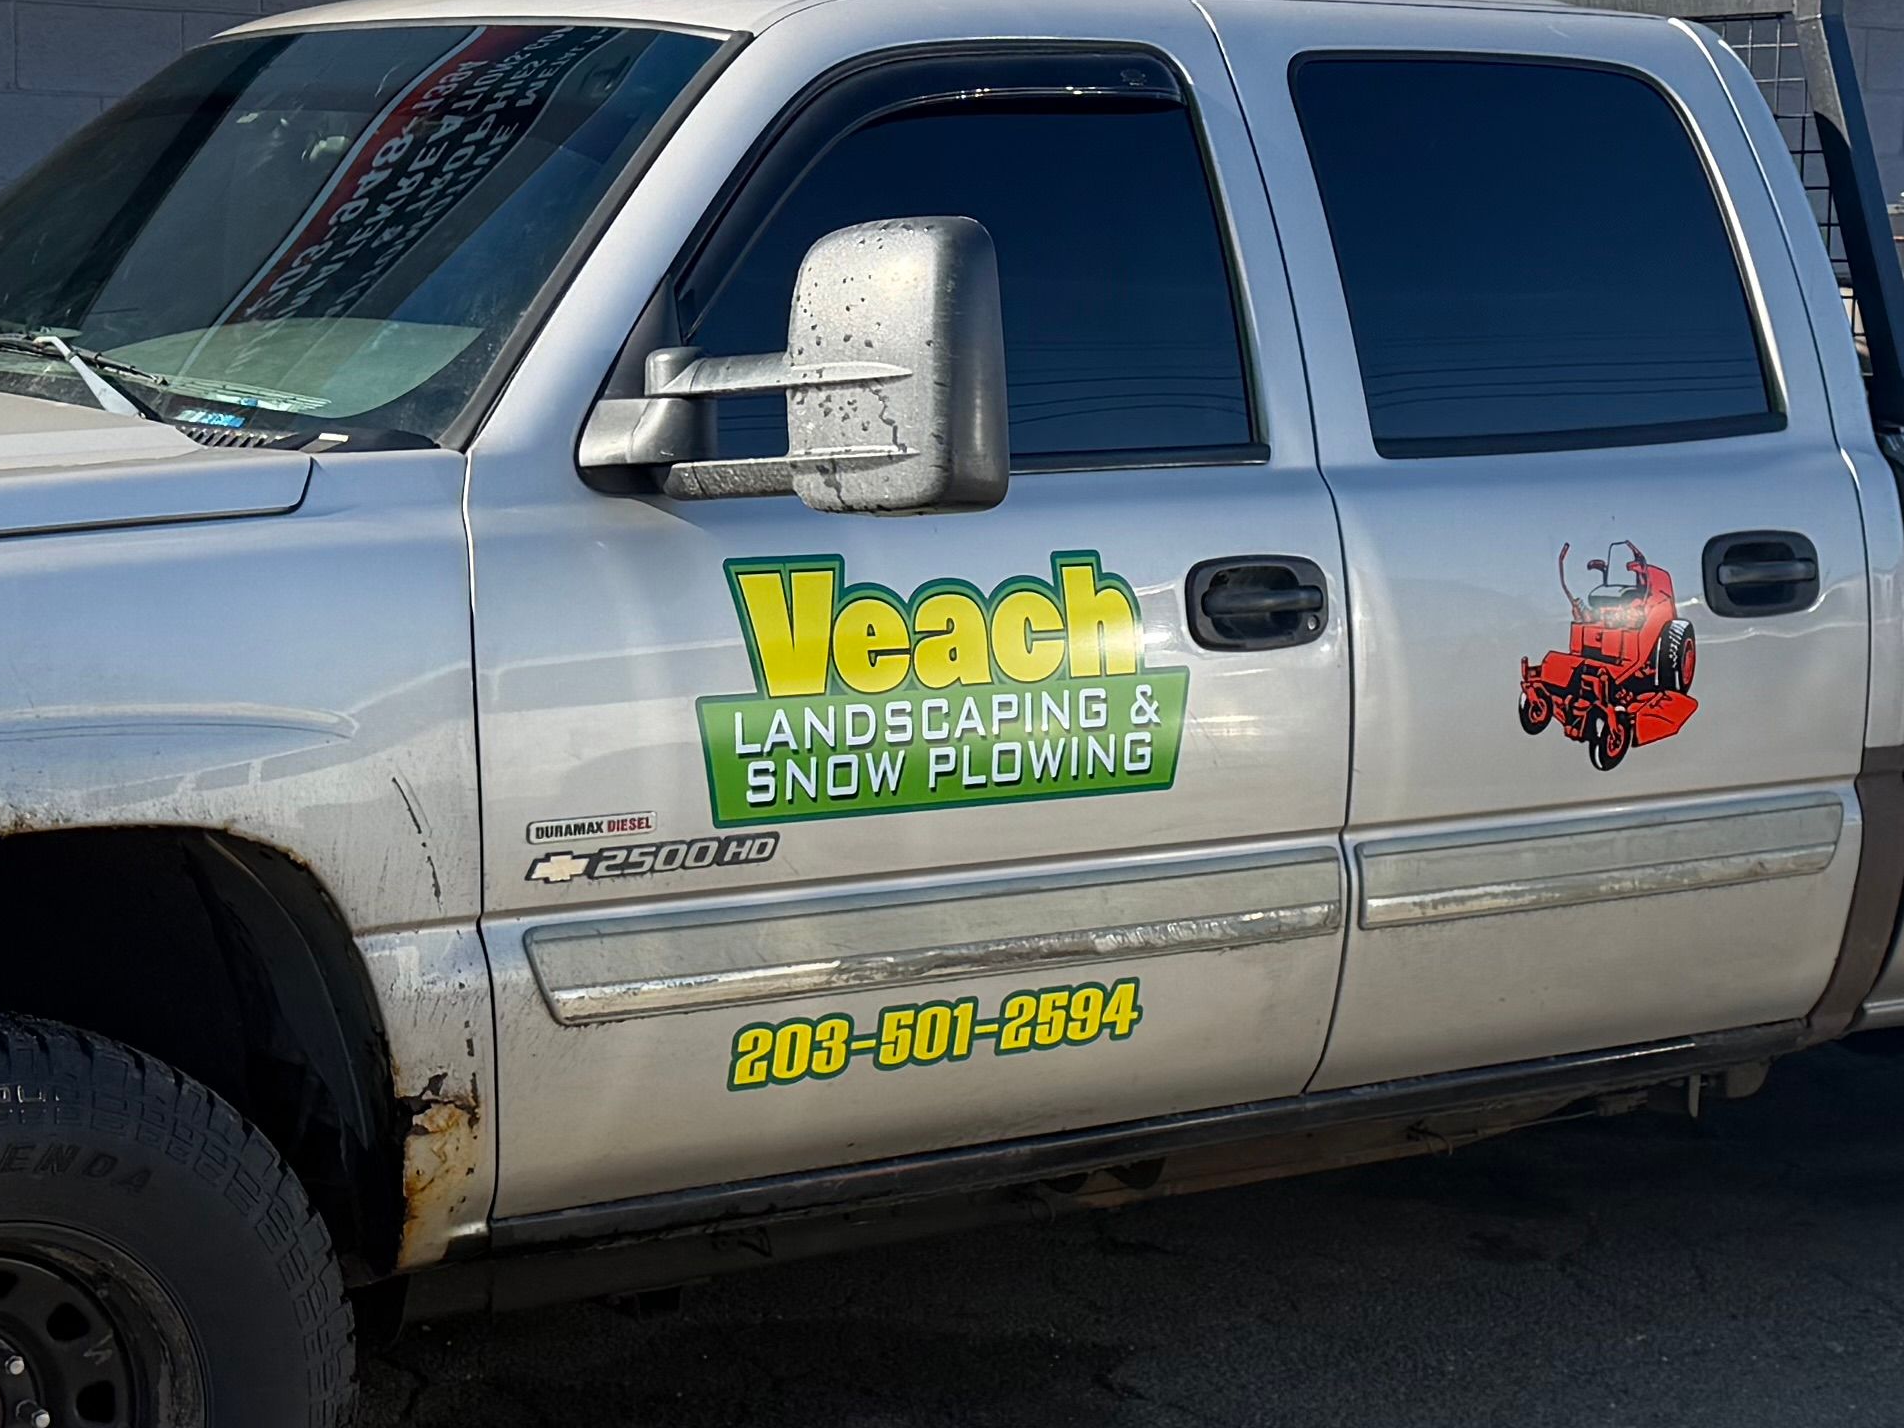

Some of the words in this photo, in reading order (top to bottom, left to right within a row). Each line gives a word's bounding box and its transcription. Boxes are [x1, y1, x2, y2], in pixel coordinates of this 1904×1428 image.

[734, 565, 1139, 699] Veach
[733, 686, 1108, 757] LANDSCAPING
[1129, 683, 1163, 726] &
[745, 750, 907, 805] SNOW
[927, 730, 1154, 789] PLOWING
[535, 820, 605, 840] DURAMAX
[607, 815, 653, 834] DIESEL
[593, 840, 720, 877] 2500
[722, 837, 776, 863] HD
[731, 982, 1140, 1087] 203-501-2594
